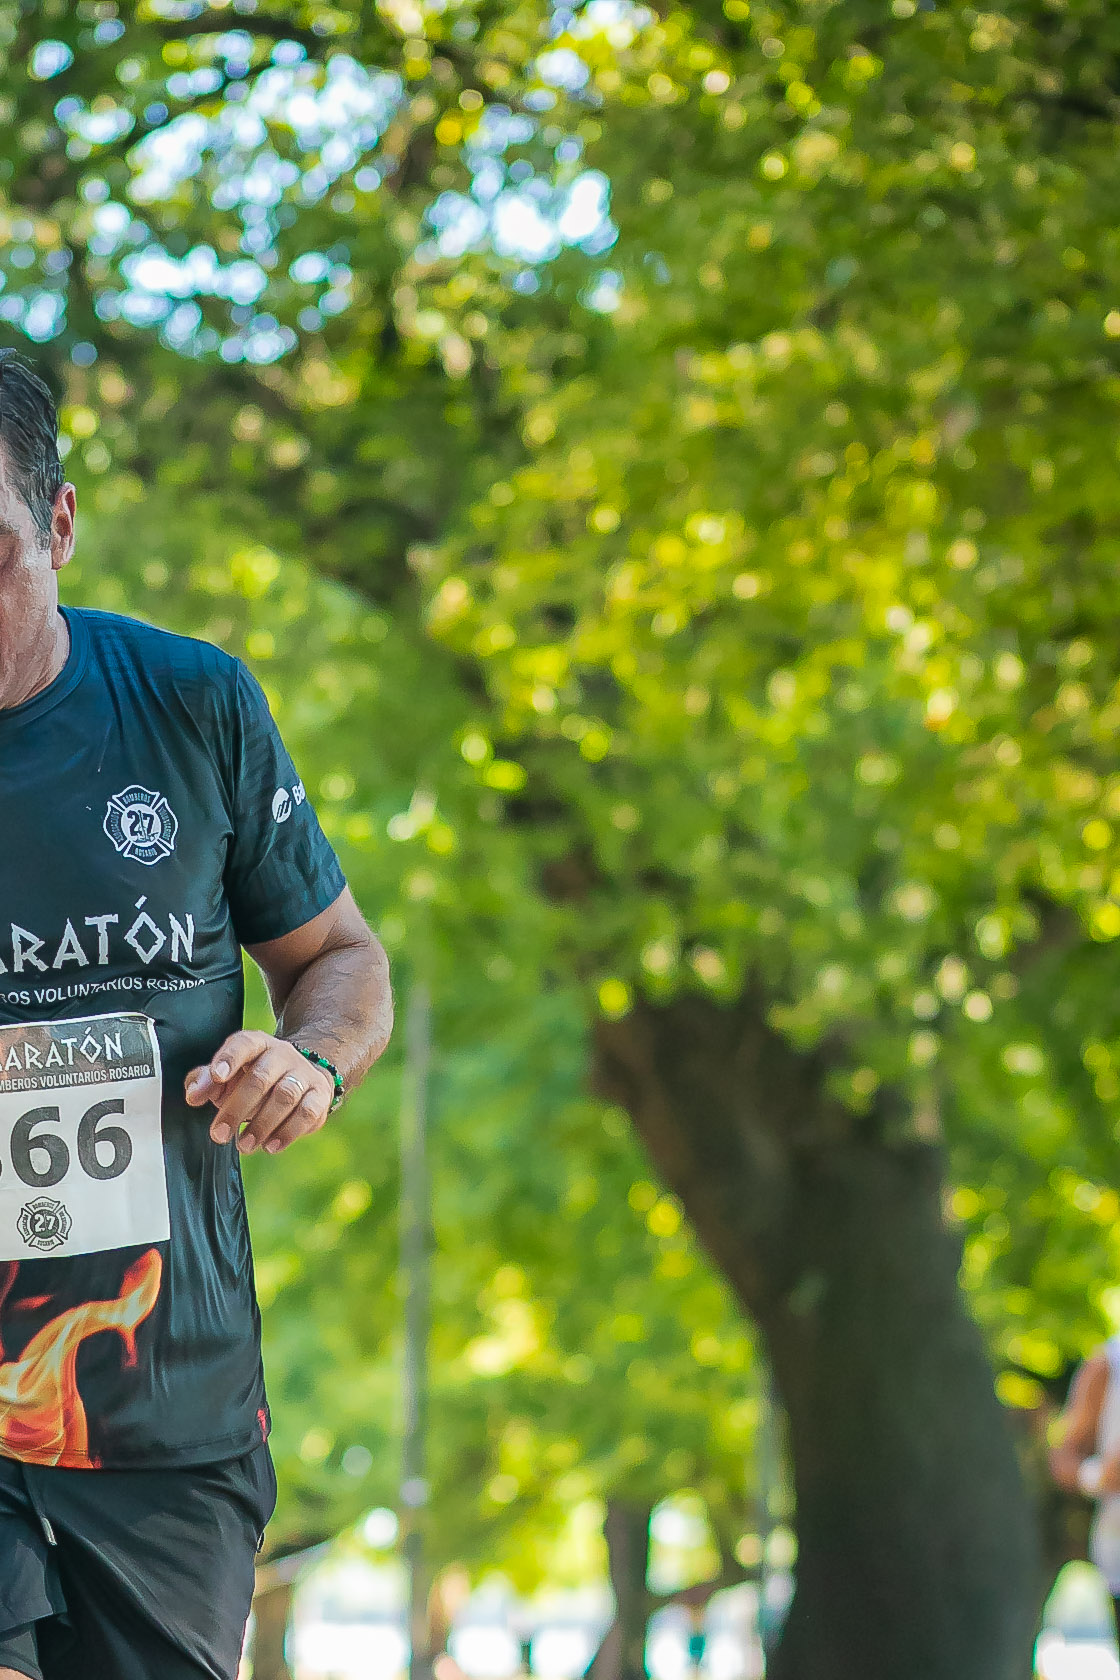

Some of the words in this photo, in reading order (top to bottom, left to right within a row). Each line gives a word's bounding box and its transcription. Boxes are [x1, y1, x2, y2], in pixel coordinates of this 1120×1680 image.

[126, 809, 155, 837] 27
[35, 977, 143, 1005] VOLUNTARIOS
[39, 1069, 108, 1089] VOLUNTARIOS
[108, 1064, 151, 1081] ROSARIO
[34, 1213, 56, 1233] 27
